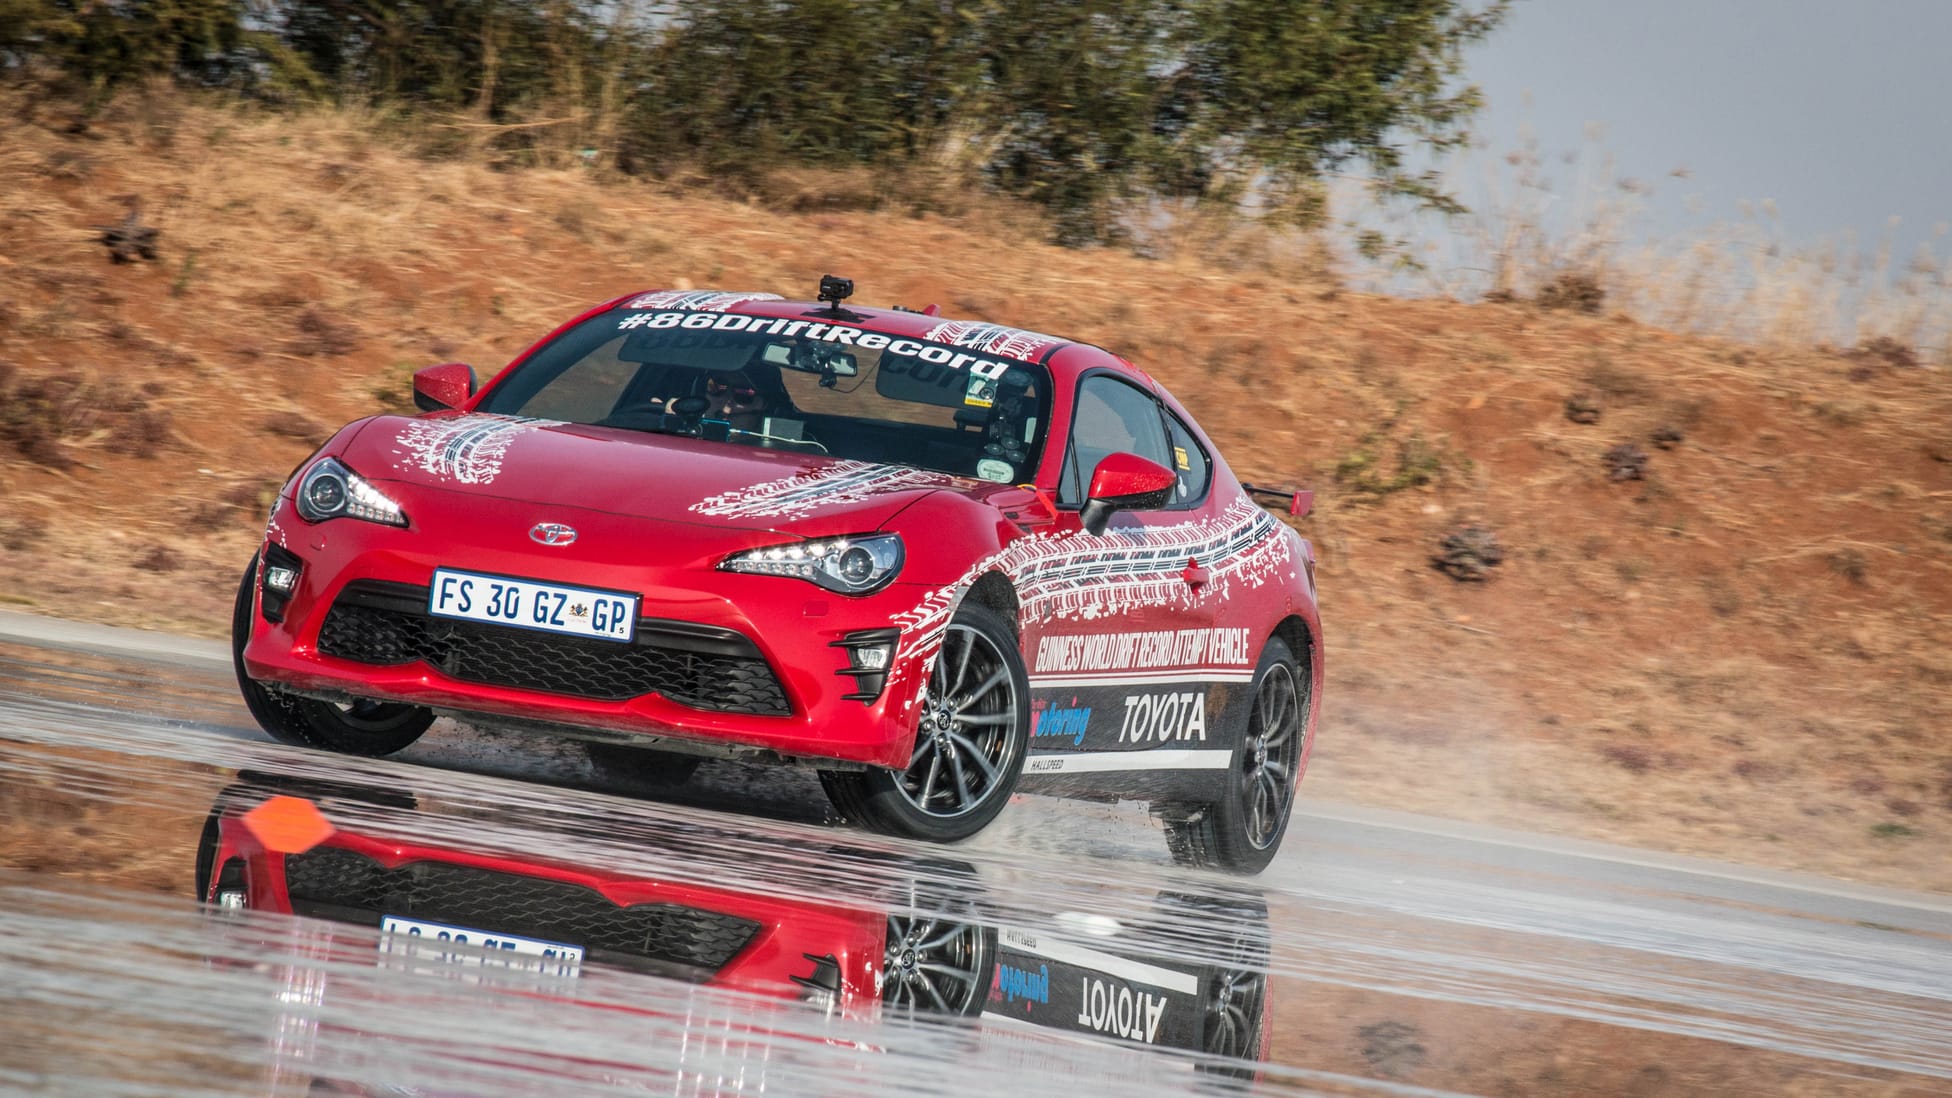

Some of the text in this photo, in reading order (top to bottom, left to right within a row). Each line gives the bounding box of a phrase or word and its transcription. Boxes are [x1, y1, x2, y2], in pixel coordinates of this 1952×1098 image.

[618, 312, 1009, 380] #86DriftRecord
[439, 577, 626, 633] FS 30 GZ GP
[1035, 627, 1250, 672] GUINNESS WORLD DRIFT RECORD ATTEMPT VEHICLE
[1119, 691, 1206, 743] TOYOTA
[1031, 758, 1064, 772] HALLSPEED
